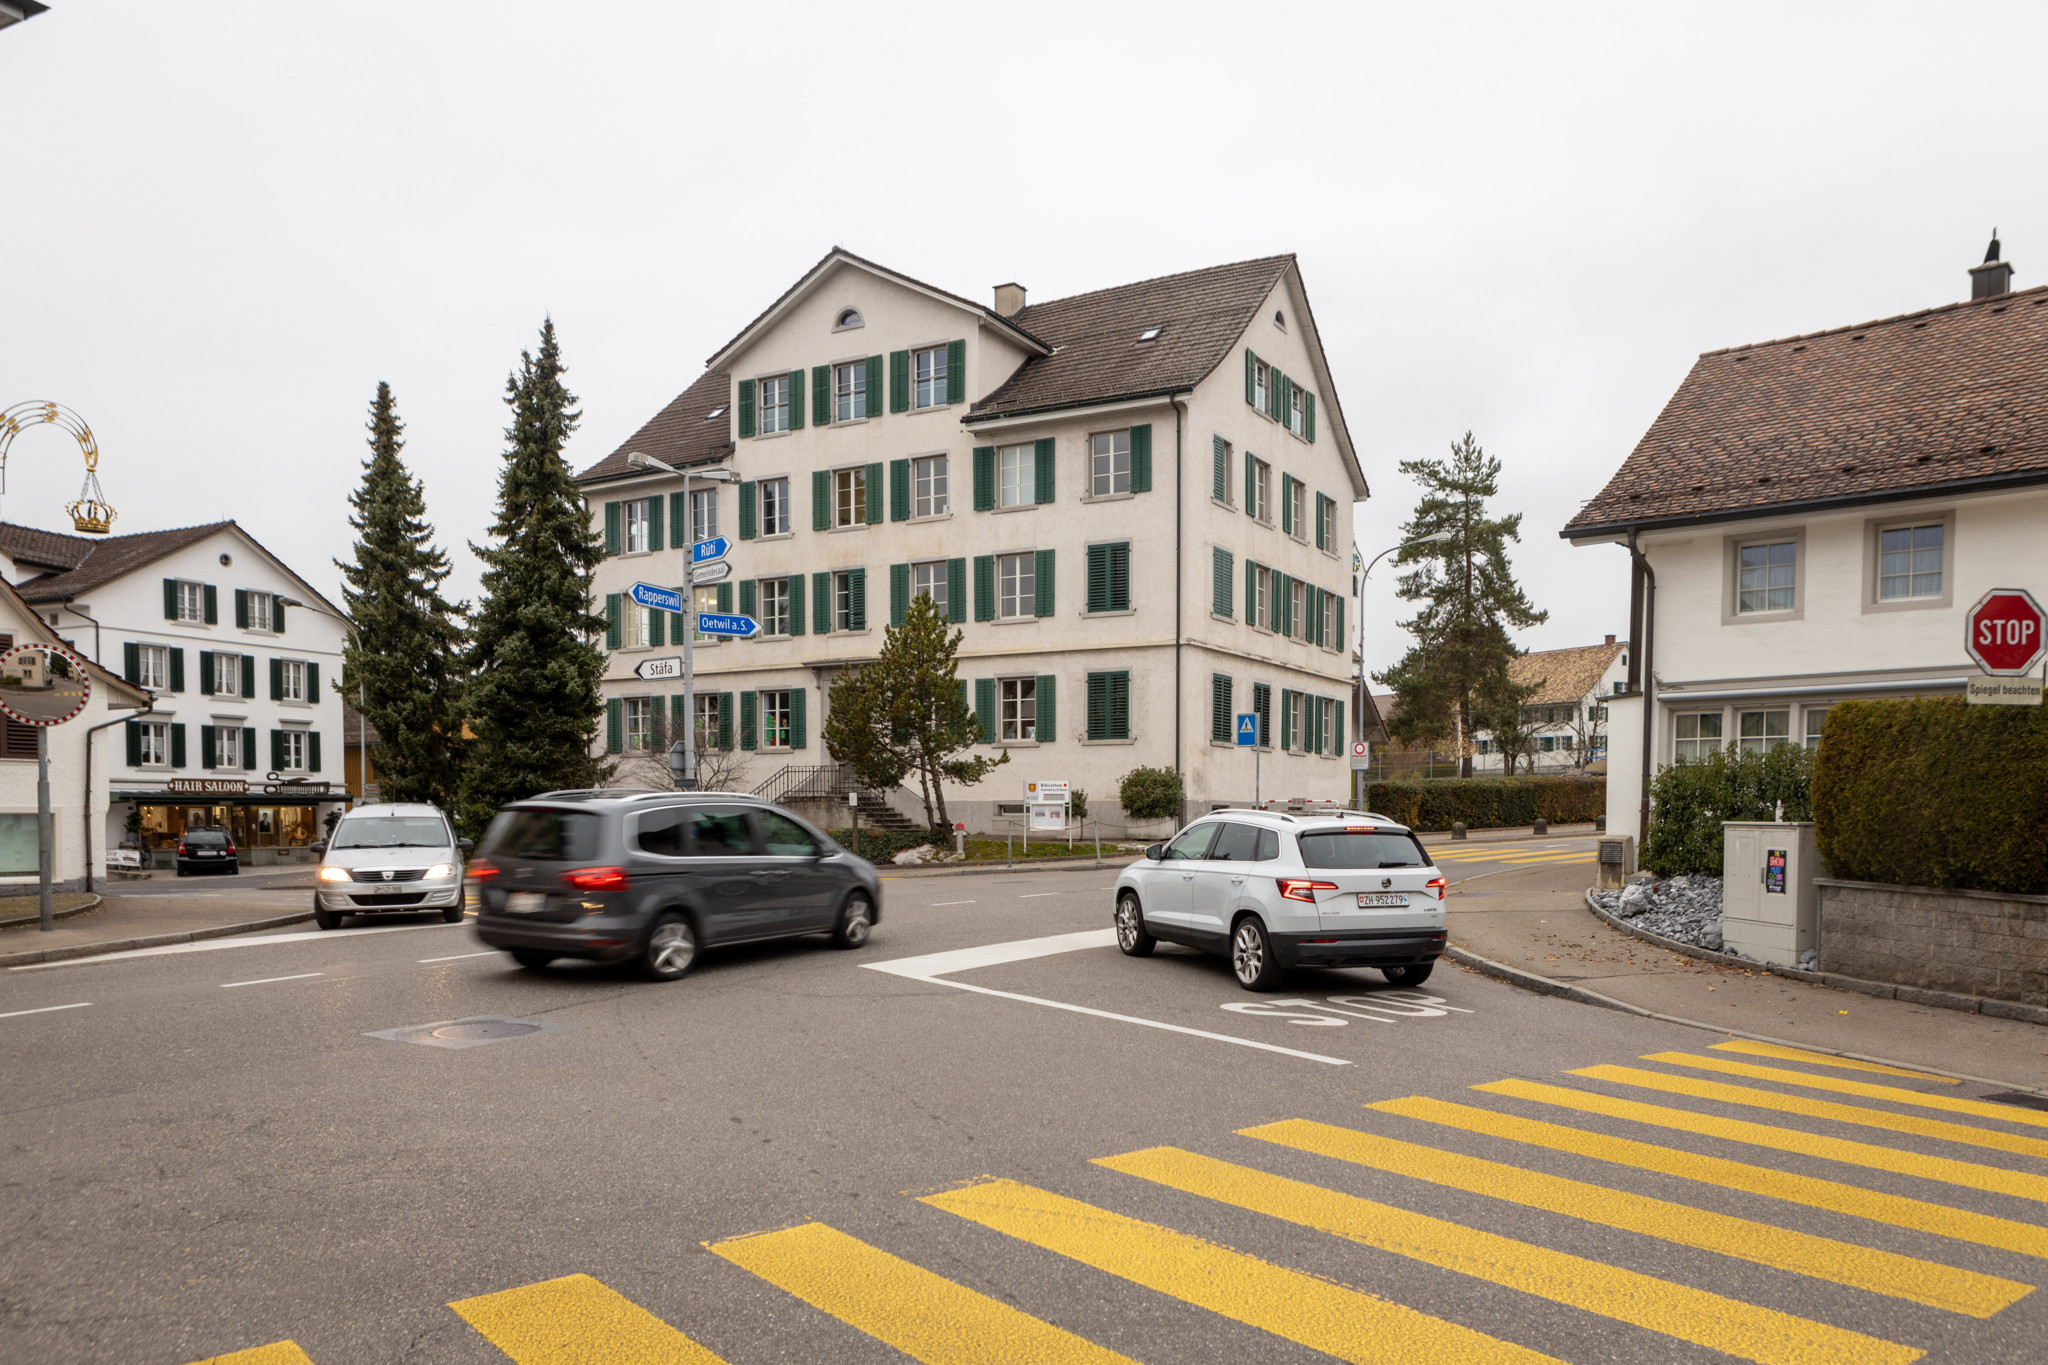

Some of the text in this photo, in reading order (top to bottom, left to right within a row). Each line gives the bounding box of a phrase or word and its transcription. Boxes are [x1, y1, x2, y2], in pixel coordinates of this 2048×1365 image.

[701, 541, 716, 557] Rüti
[694, 565, 725, 580] Gemeindesaal
[638, 586, 680, 608] Rapperswil
[701, 617, 730, 630] Oetwil
[1978, 619, 2035, 646] STOP
[650, 662, 673, 675] Stäfa
[1969, 684, 2041, 696] Spiegel beachten
[174, 780, 244, 792] HAIR SALOON
[1769, 856, 1785, 866] SHOW
[1219, 990, 1476, 1027] STOP
